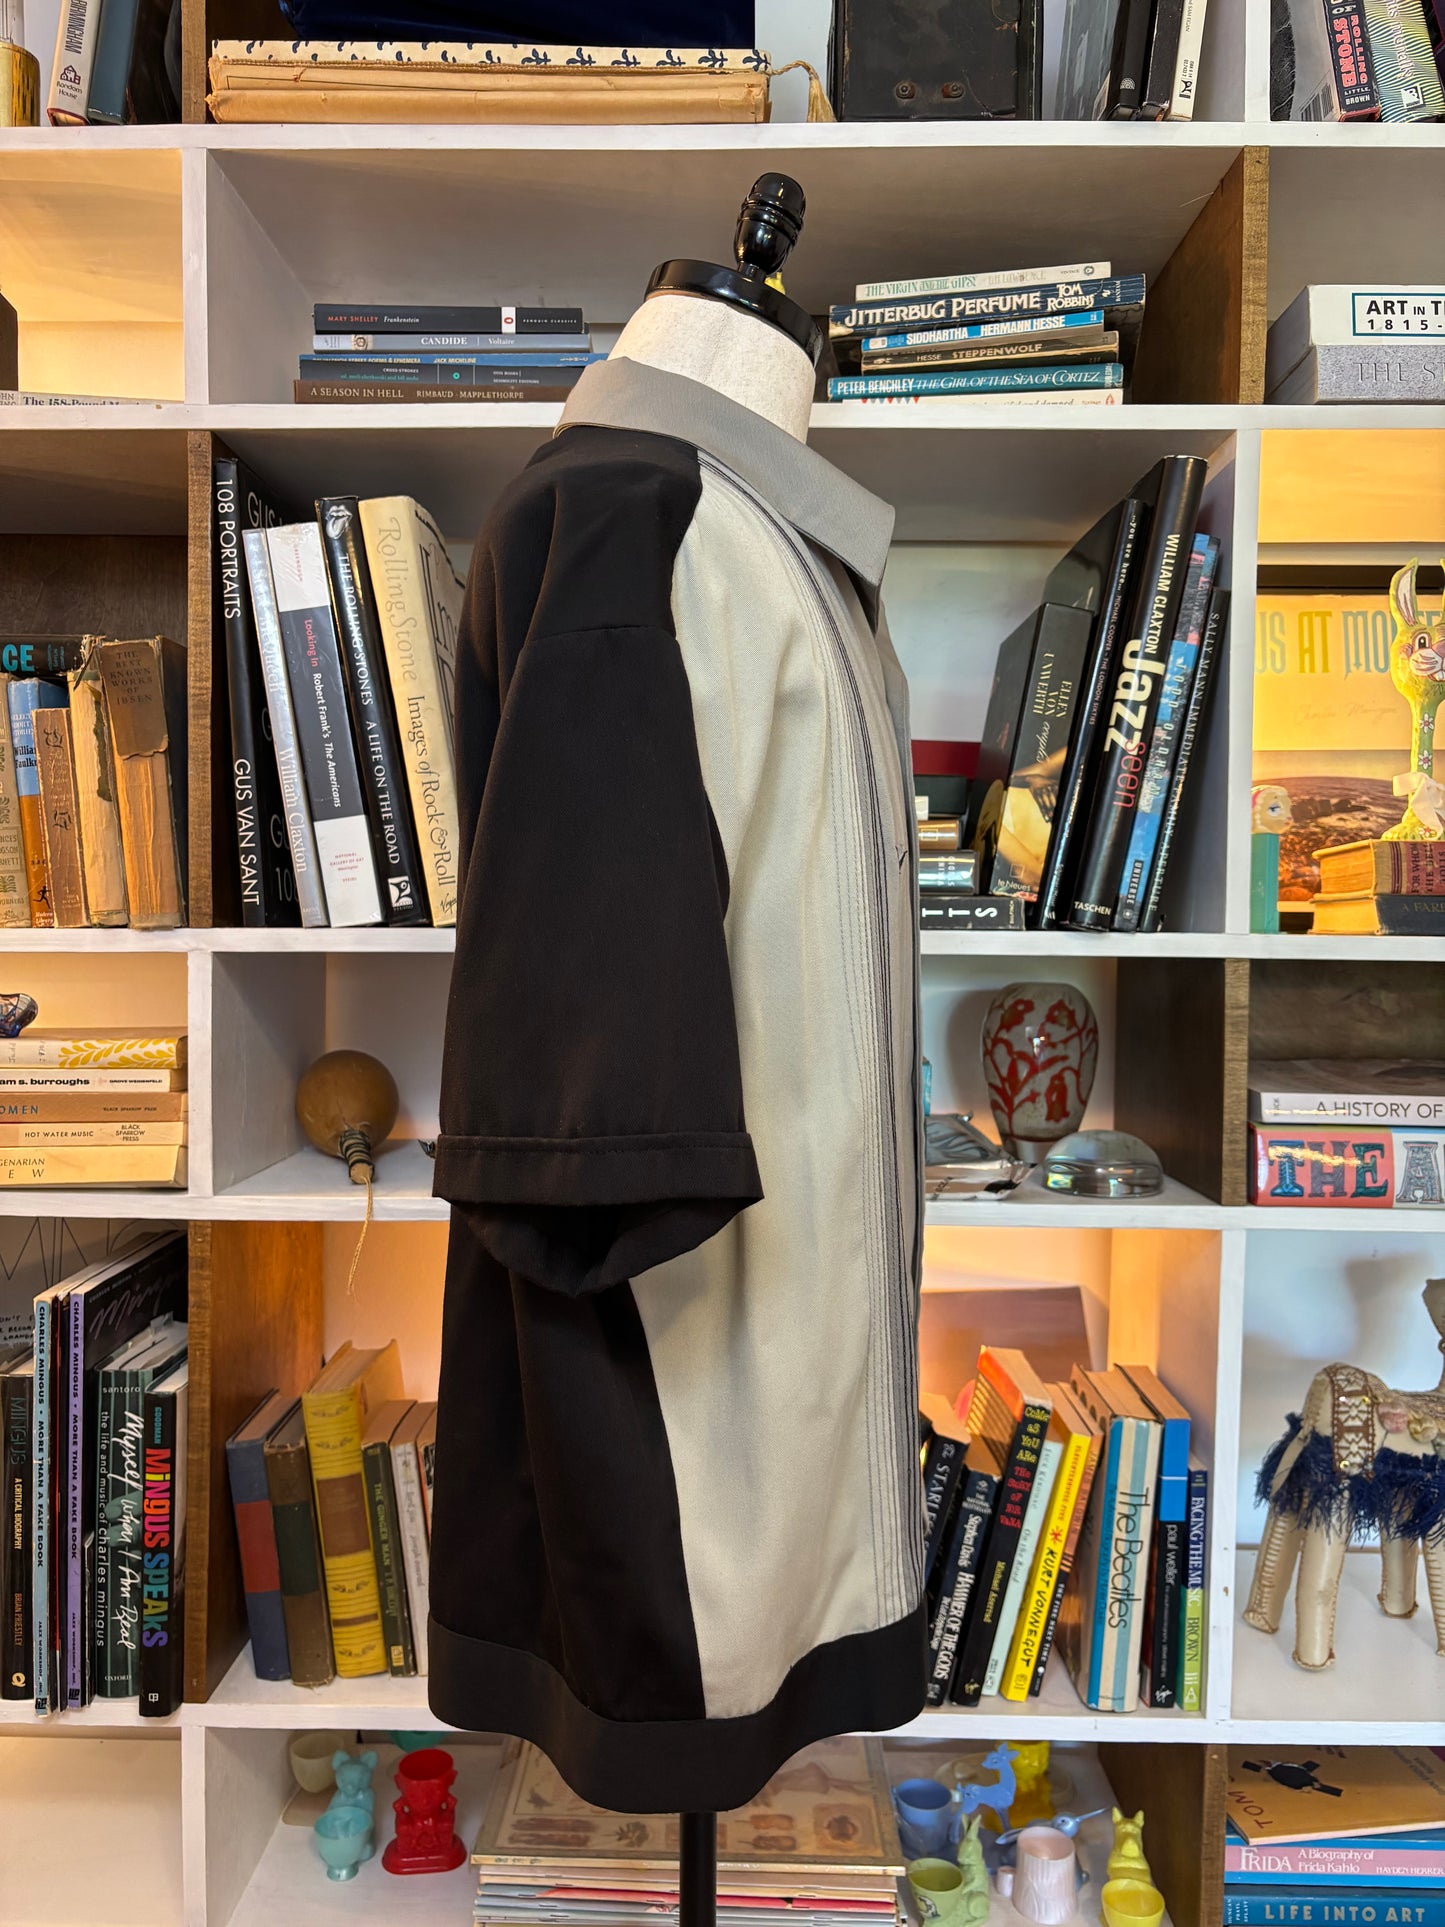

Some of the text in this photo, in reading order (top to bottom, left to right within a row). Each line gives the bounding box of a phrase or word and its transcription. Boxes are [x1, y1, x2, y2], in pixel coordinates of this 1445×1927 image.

[65, 0, 87, 54] BIRMINGHAM
[1332, 5, 1356, 14] OF
[1333, 17, 1357, 88] STONE
[1350, 14, 1368, 84] ROLLING
[56, 81, 82, 94] Random
[58, 89, 78, 99] House
[1345, 94, 1370, 105] BROWN
[866, 281, 918, 297] THE VIRGIN
[1046, 293, 1096, 311] ROBBINS
[1056, 283, 1083, 296] TOM
[844, 291, 1041, 327] JITTERBUG PERFUME
[1366, 300, 1425, 315] ART IN
[421, 337, 515, 345] CANDIDE Voltaire
[906, 315, 1066, 345] SIDDHARTHA HERMANN HESSE
[951, 343, 1043, 359] STEPPENWOLF
[837, 370, 1100, 395] PETER BENCHLEY GIRL CORTEZ
[1353, 362, 1408, 382] THE
[311, 388, 404, 398] A SEASON IN HELL
[416, 390, 524, 399] RIMBAUD MAPPLETHORPE
[217, 479, 241, 620] 108 PORTRAITS
[1145, 534, 1180, 654] WILLIAM CLAXTON
[1095, 595, 1122, 700] MICHAEL COOPER LONDON
[1206, 612, 1220, 654] SALLY
[1298, 610, 1332, 674] AT
[1033, 653, 1055, 714] UNWERTH
[1104, 639, 1166, 756] Jazz
[1195, 658, 1210, 702] MANN
[304, 619, 342, 808] Looking Robert Frank's Americans
[338, 553, 400, 865] THE ROLLING STONES LIFE ON THE ROAD
[377, 516, 456, 887] Rolling Stone Images of Rock Roll
[1045, 691, 1058, 715] VON
[1056, 681, 1072, 717] ELLEN
[1174, 703, 1201, 782] IMMEDIATE
[279, 748, 307, 873] William Claxton
[234, 758, 260, 906] GUS VAN SANT
[1126, 862, 1142, 904] UNIVERSE
[1411, 877, 1420, 893] FOR
[1073, 901, 1111, 915] TASCHEN
[30, 1078, 90, 1086] burroughs
[1315, 1101, 1443, 1119] A HISTORY OF
[71, 1130, 94, 1138] MUSIC
[1268, 1139, 1390, 1198] THE
[101, 1411, 110, 1429] the
[153, 1407, 162, 1444] GOODMAN
[101, 1432, 110, 1450] life
[11, 1397, 27, 1550] MINGUS BIOGRAPHY
[375, 1498, 391, 1566] GINGER MAN
[1165, 1523, 1179, 1549] paul
[98, 1527, 107, 1584] charles
[957, 1543, 975, 1567] Davis
[1108, 1487, 1151, 1629] The Beatles
[1164, 1550, 1178, 1585] weller
[1185, 1496, 1206, 1662] FACING THE MUSIC BROWN
[14, 1593, 22, 1646] BRIAN PRIESTLEY
[95, 1590, 105, 1647] mingus
[1020, 1546, 1058, 1668] KURT VONNEGUT
[934, 1571, 976, 1680] HAMMER GODS
[1228, 1790, 1273, 1829] TOM
[1239, 1846, 1291, 1871] FRIDA
[1298, 1849, 1375, 1862] A Biography of
[1298, 1861, 1360, 1873] Frida Kahlo
[1376, 1866, 1409, 1874] HAYDEN
[1265, 1904, 1425, 1922] LIFE INTO ART
